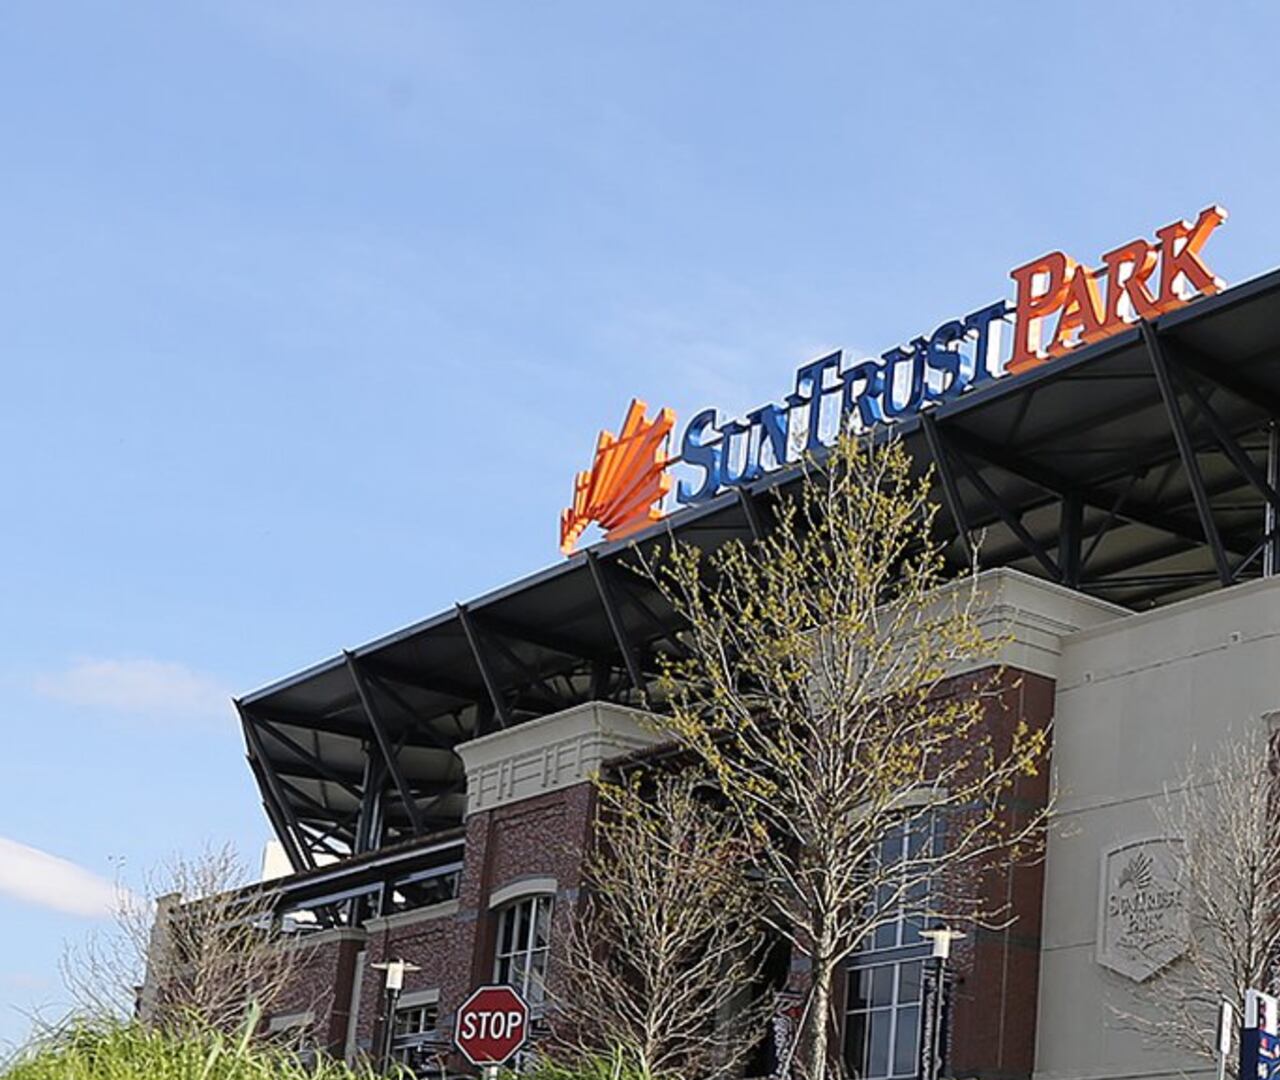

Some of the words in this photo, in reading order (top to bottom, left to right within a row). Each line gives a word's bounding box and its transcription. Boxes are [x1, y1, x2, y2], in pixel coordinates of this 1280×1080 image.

[676, 298, 1016, 504] SUNTRUST
[1005, 203, 1229, 374] PARK
[461, 1011, 522, 1040] STOP
